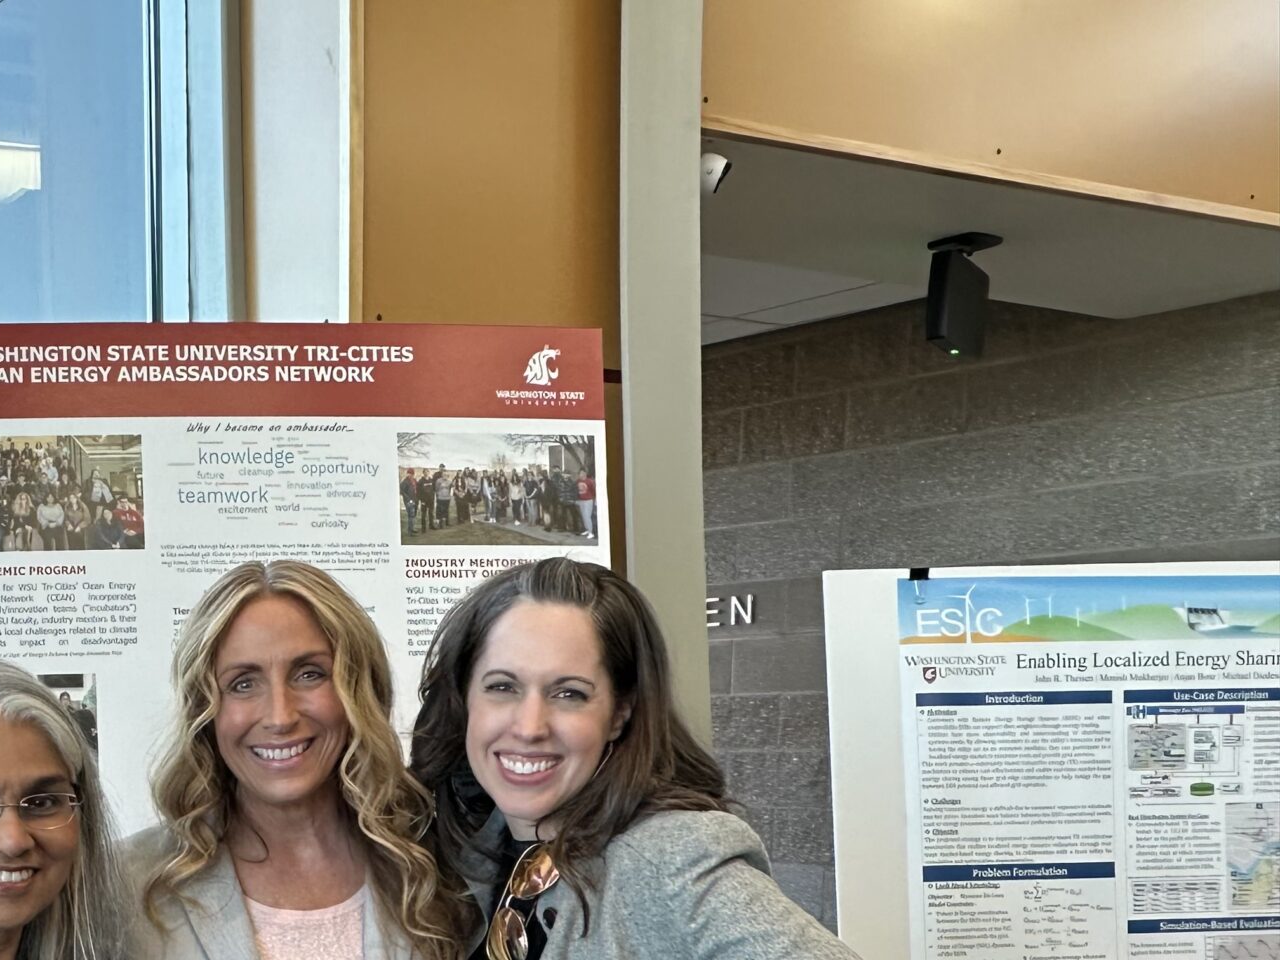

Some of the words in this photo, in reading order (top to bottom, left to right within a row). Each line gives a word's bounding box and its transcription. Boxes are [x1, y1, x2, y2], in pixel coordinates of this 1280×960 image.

[106, 344, 170, 362] STATE
[174, 344, 299, 362] UNIVERSITY
[302, 344, 414, 363] TRI-CITIES
[30, 365, 112, 383] ENERGY
[116, 364, 270, 383] AMBASSADORS
[274, 365, 375, 383] NETWORK
[185, 421, 211, 434] Why
[214, 421, 222, 432] I
[268, 424, 282, 432] an
[198, 448, 295, 468] knowledge
[197, 470, 224, 480] future
[301, 463, 379, 476] opportunity
[287, 481, 332, 490] innovation
[178, 486, 268, 503] teamwork
[326, 490, 367, 499] advocacy
[218, 505, 268, 514] excitement
[275, 503, 300, 512] world
[311, 520, 349, 529] curiosity
[28, 564, 87, 576] PROGRAM
[905, 655, 976, 667] WASHINGTON
[977, 654, 1007, 665] STATE
[1016, 653, 1087, 671] Enabling
[1093, 651, 1170, 668] Localized
[1175, 651, 1230, 670] Energy
[939, 666, 997, 678] UNIVERSITY
[985, 695, 1044, 704] Introduction
[1173, 691, 1215, 701] Use-Case
[1217, 690, 1268, 699] Description
[973, 869, 1011, 877] Problem
[1013, 866, 1067, 876] Formulation
